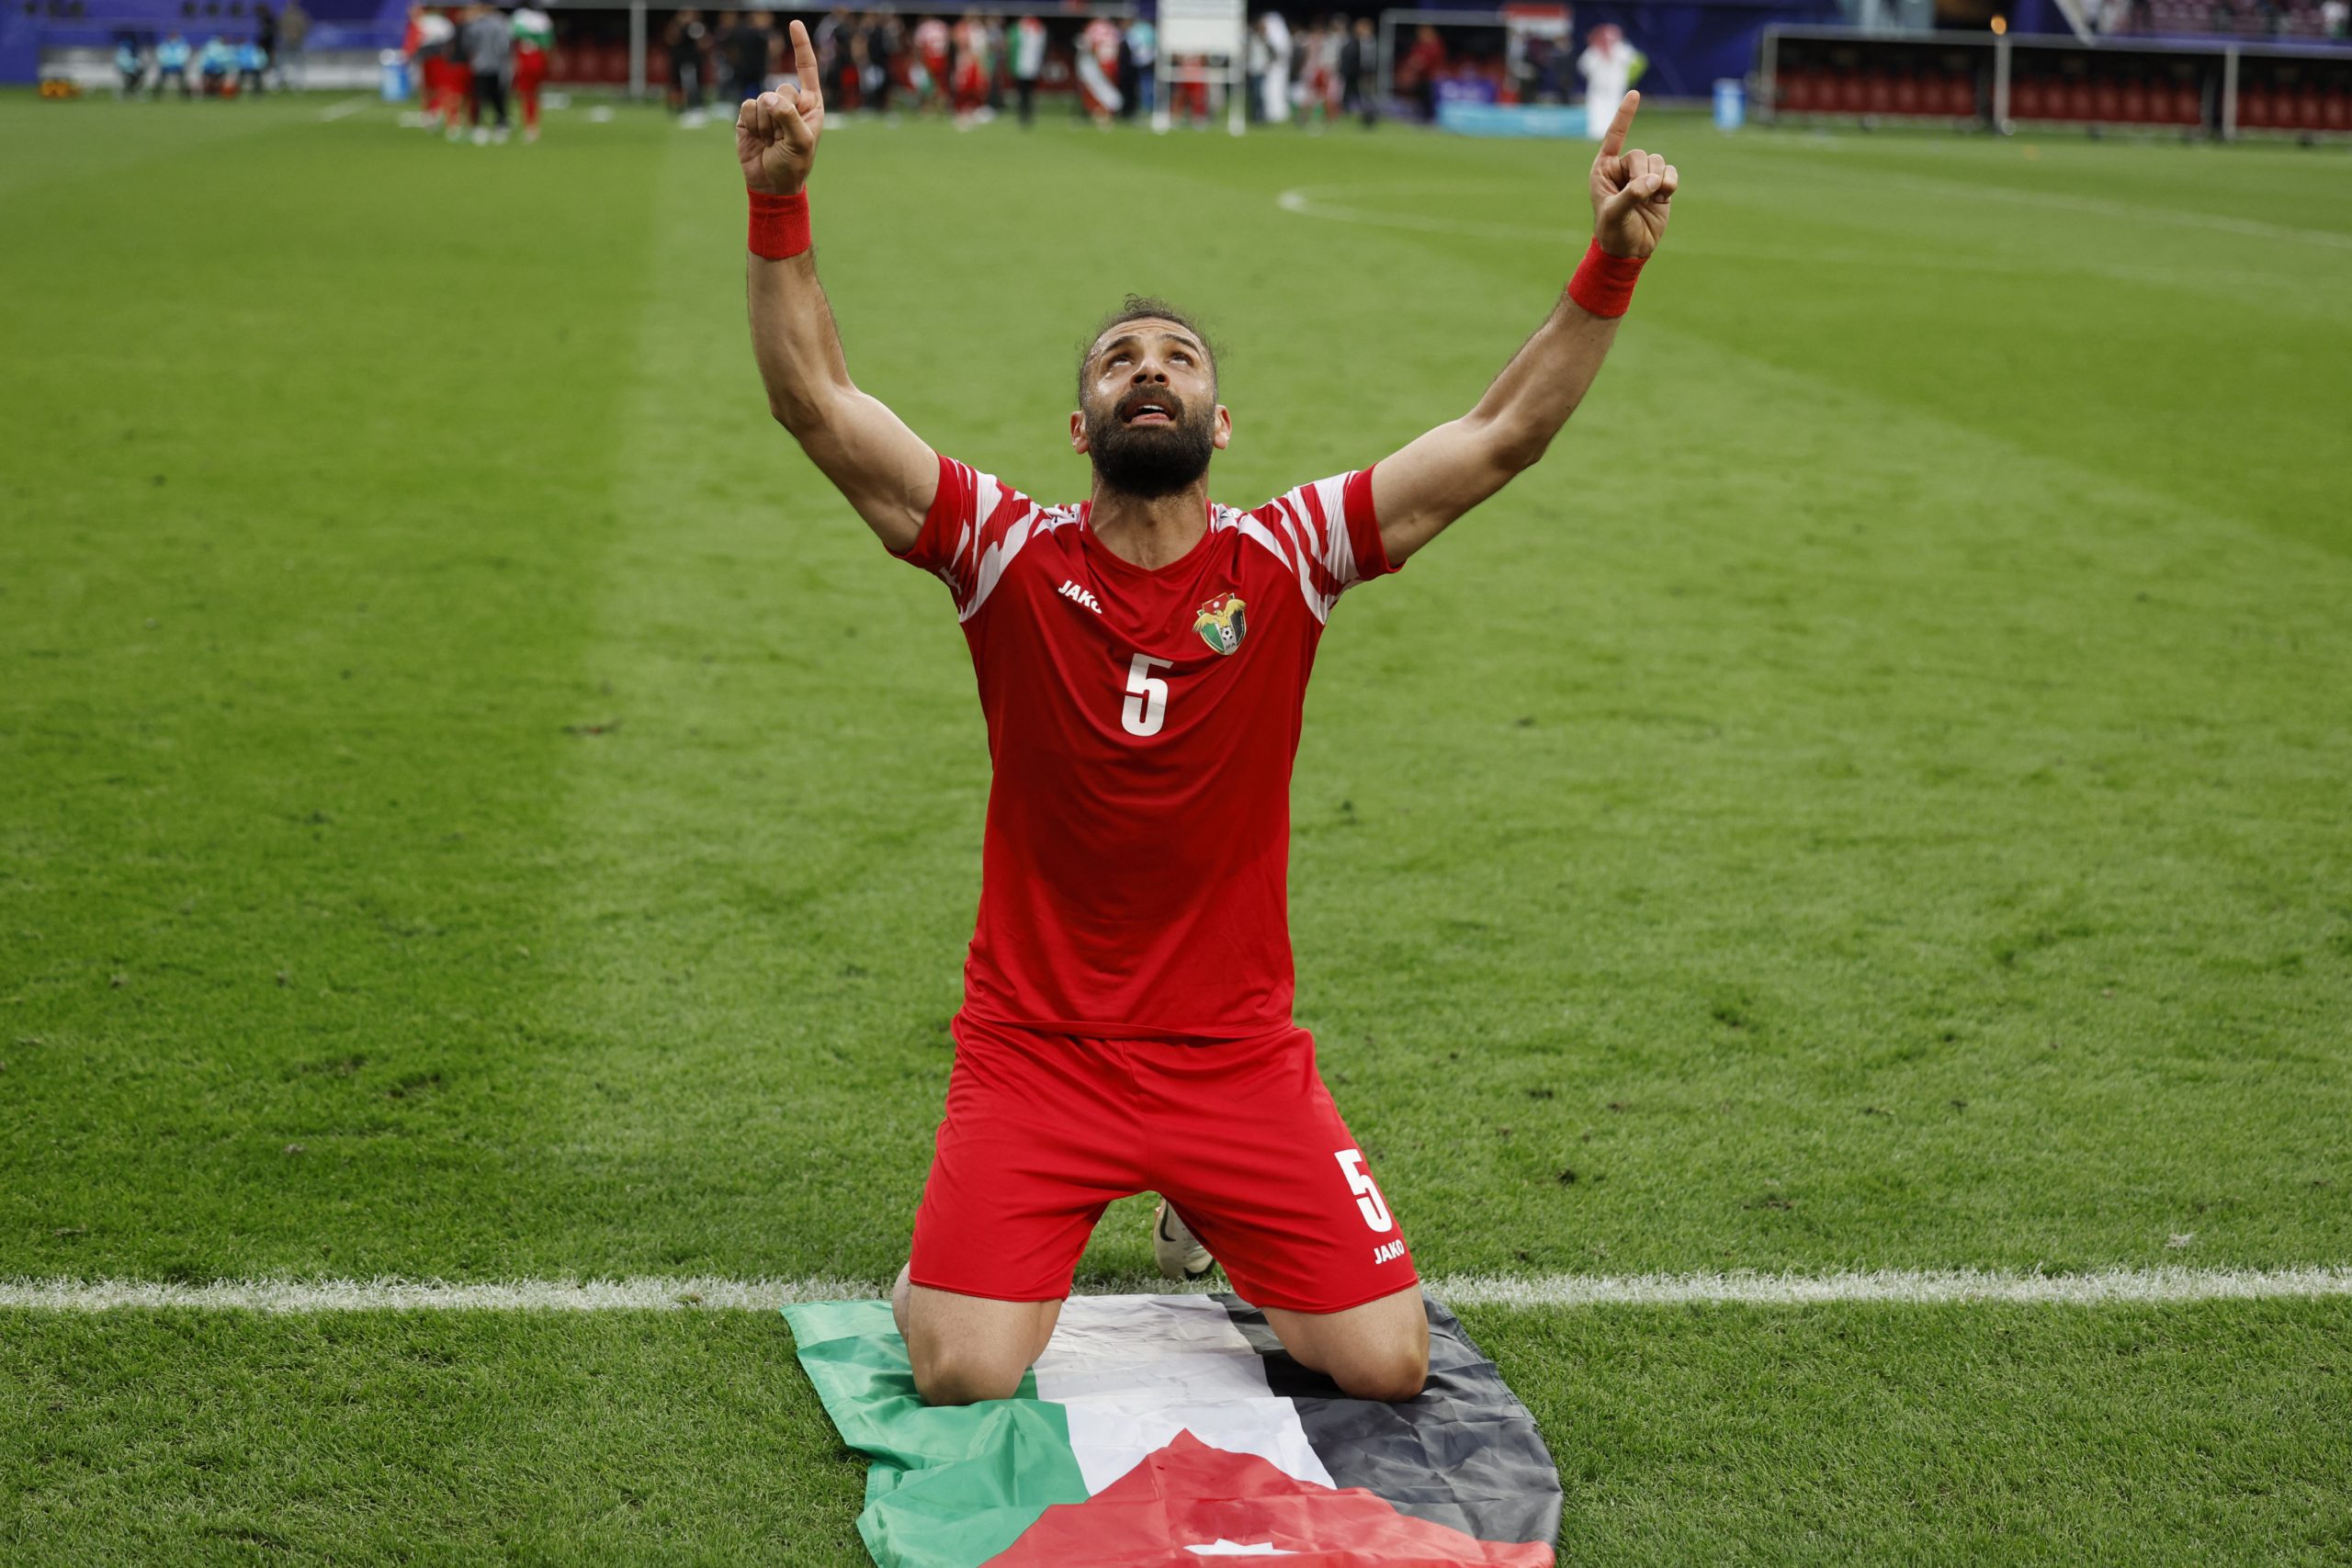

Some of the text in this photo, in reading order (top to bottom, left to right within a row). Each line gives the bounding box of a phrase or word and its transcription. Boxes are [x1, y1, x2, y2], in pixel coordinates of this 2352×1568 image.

[1121, 652, 1174, 737] 5
[1334, 1148, 1393, 1233] 5
[1374, 1239, 1406, 1265] JAKO
